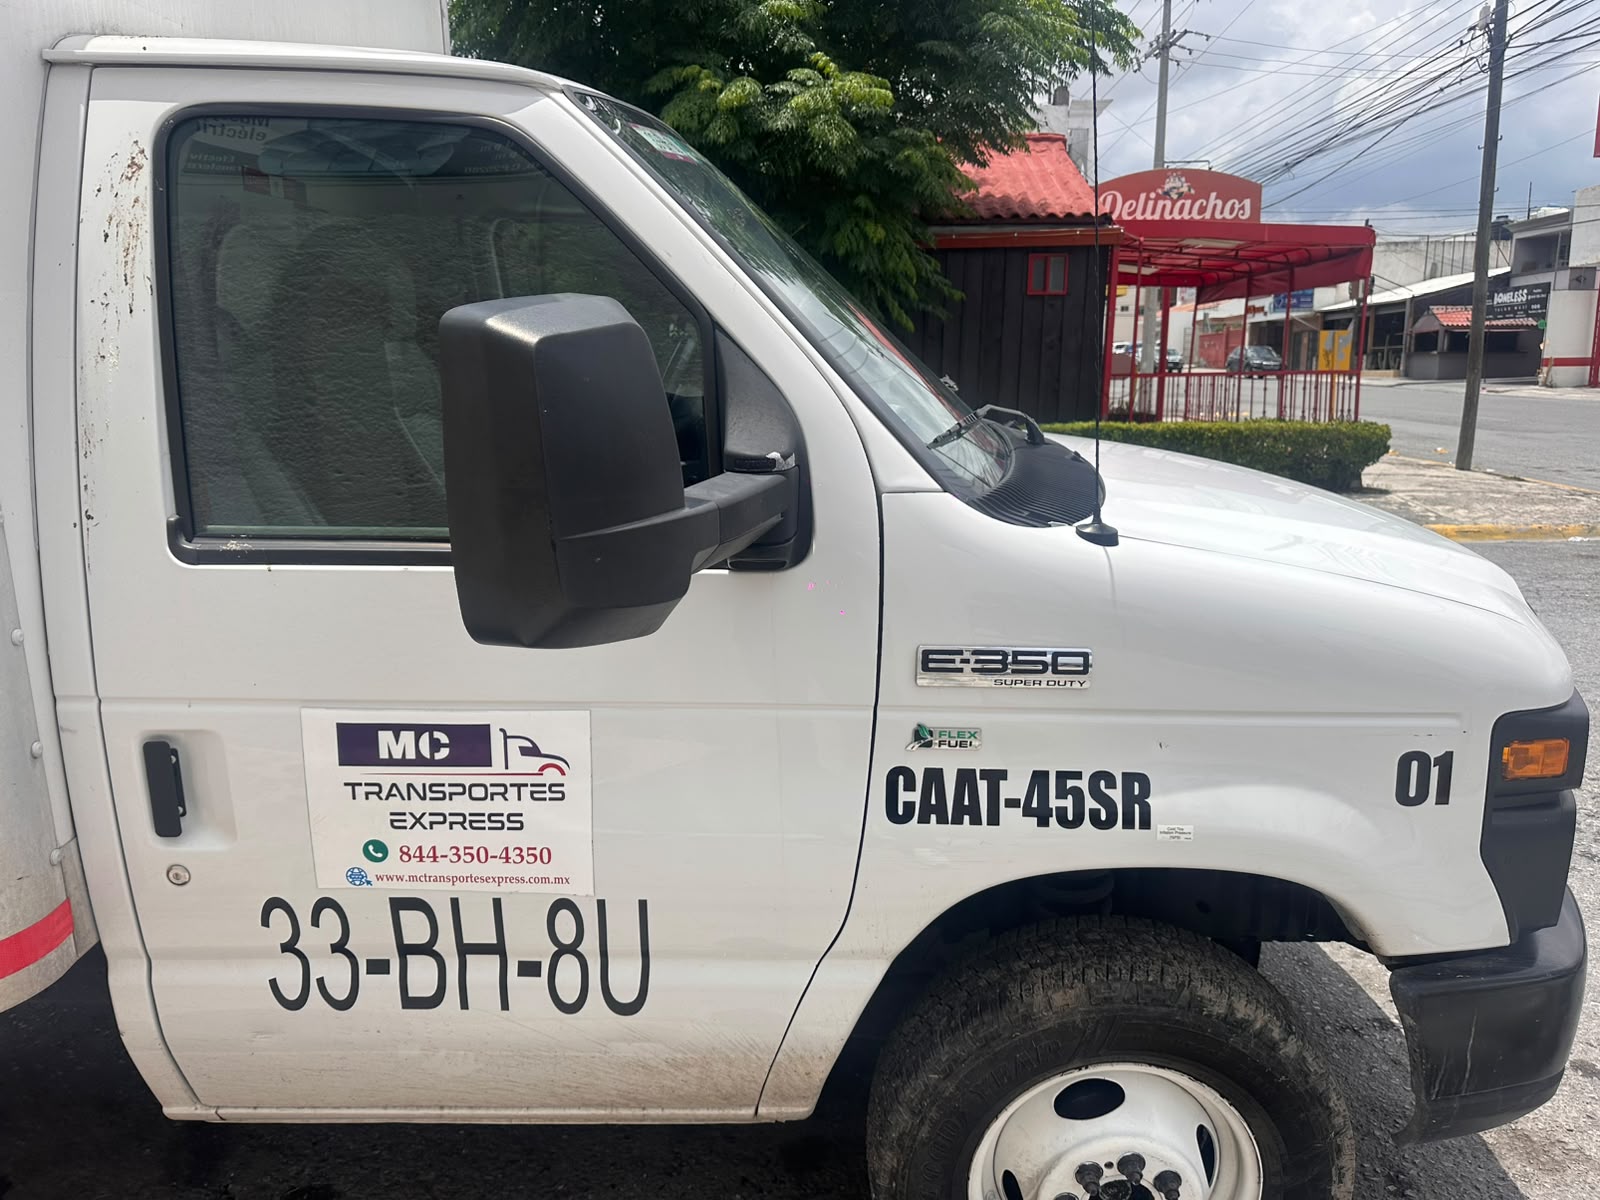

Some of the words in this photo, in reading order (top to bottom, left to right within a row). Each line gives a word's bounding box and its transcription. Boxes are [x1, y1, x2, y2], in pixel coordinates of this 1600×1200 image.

[1099, 190, 1251, 221] Delinachos
[921, 649, 1090, 675] E-350
[993, 678, 1042, 687] SUPER
[1046, 679, 1087, 688] DUTY
[377, 730, 450, 761] MC
[938, 730, 978, 740] FLEX
[1395, 750, 1454, 807] 01
[343, 782, 566, 802] TRANSPORTES
[885, 765, 1152, 831] CAAT-45SR
[389, 811, 525, 831] EXPRESS
[399, 845, 552, 864] 844-350-4350
[375, 872, 571, 887] www.mctransportesexpress.com.mx
[260, 897, 651, 1016] 33-BH-8U
